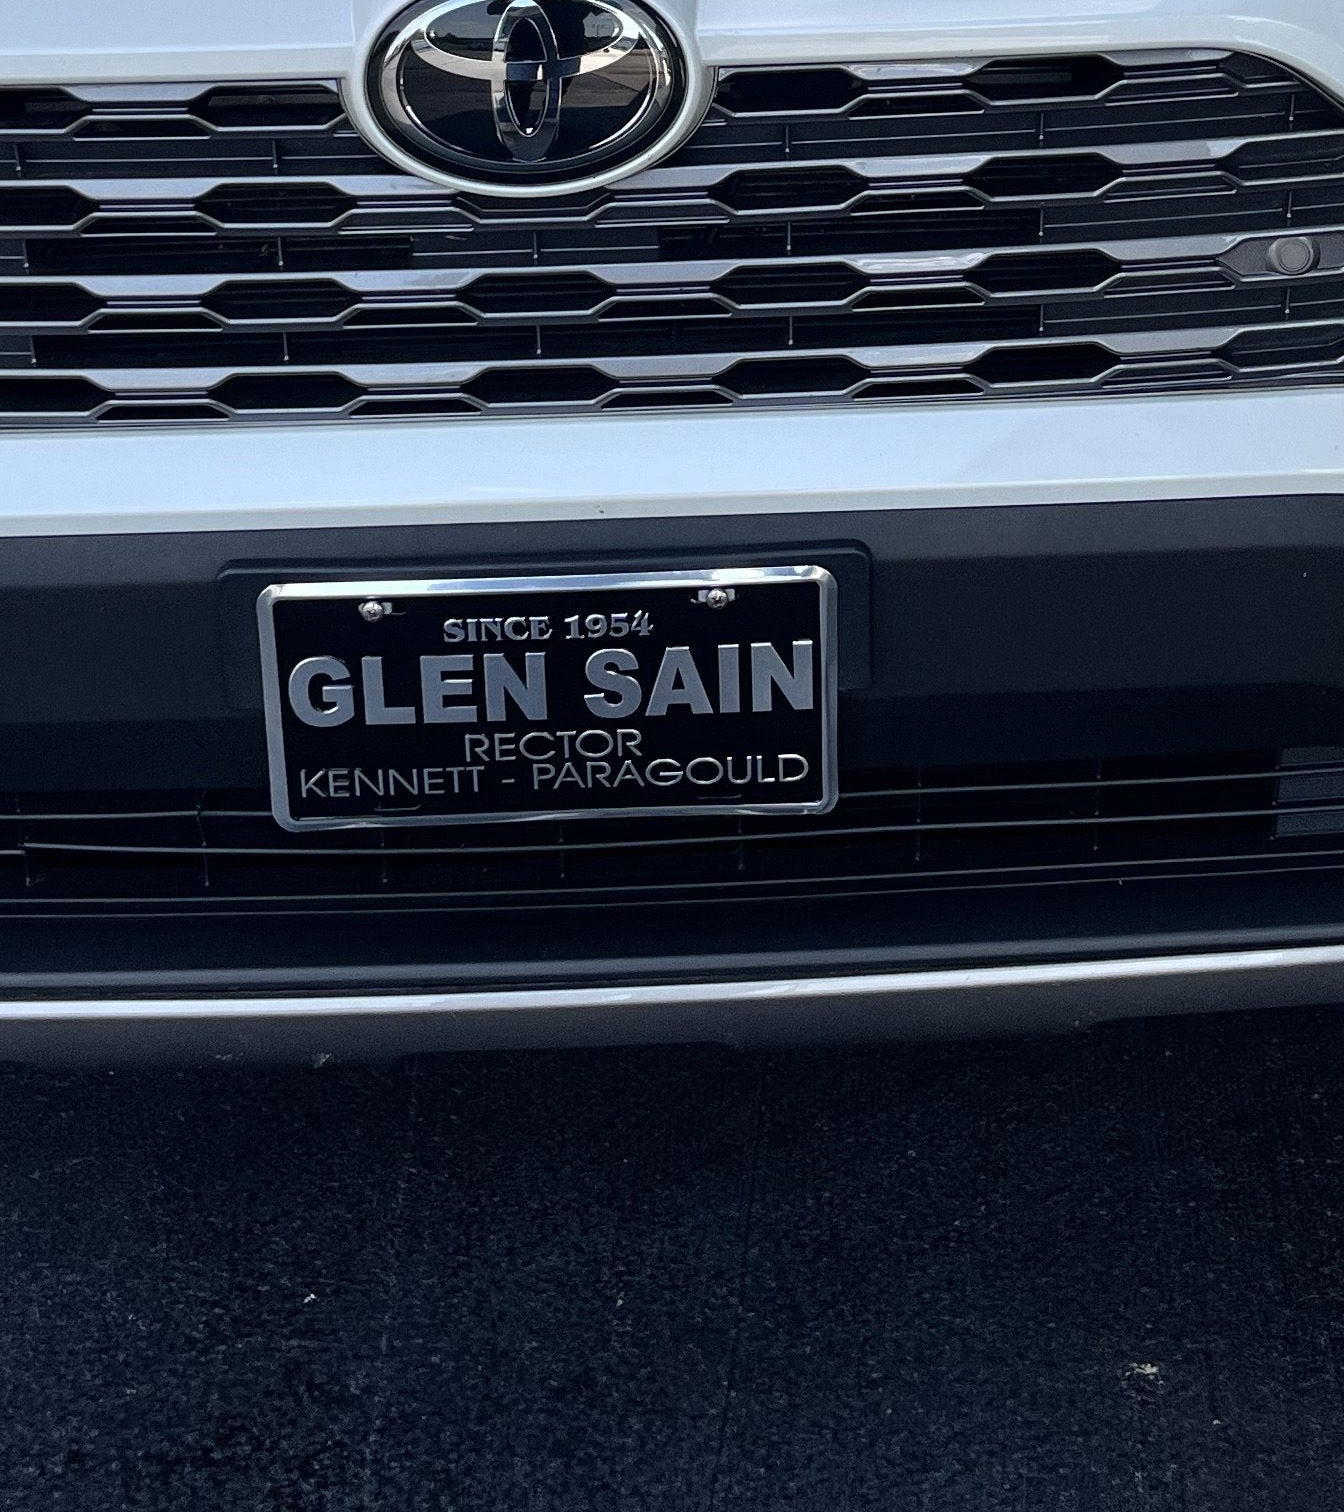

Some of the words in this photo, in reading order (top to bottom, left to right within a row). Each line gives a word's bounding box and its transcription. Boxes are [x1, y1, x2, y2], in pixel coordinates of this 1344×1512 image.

[443, 616, 553, 643] SINCE
[564, 609, 654, 640] 1954
[287, 651, 548, 727] GLEN
[583, 639, 815, 719] SAIN
[464, 728, 643, 763] RECTOR
[299, 765, 486, 798] KENNETT
[532, 752, 810, 789] PARAGOULD
